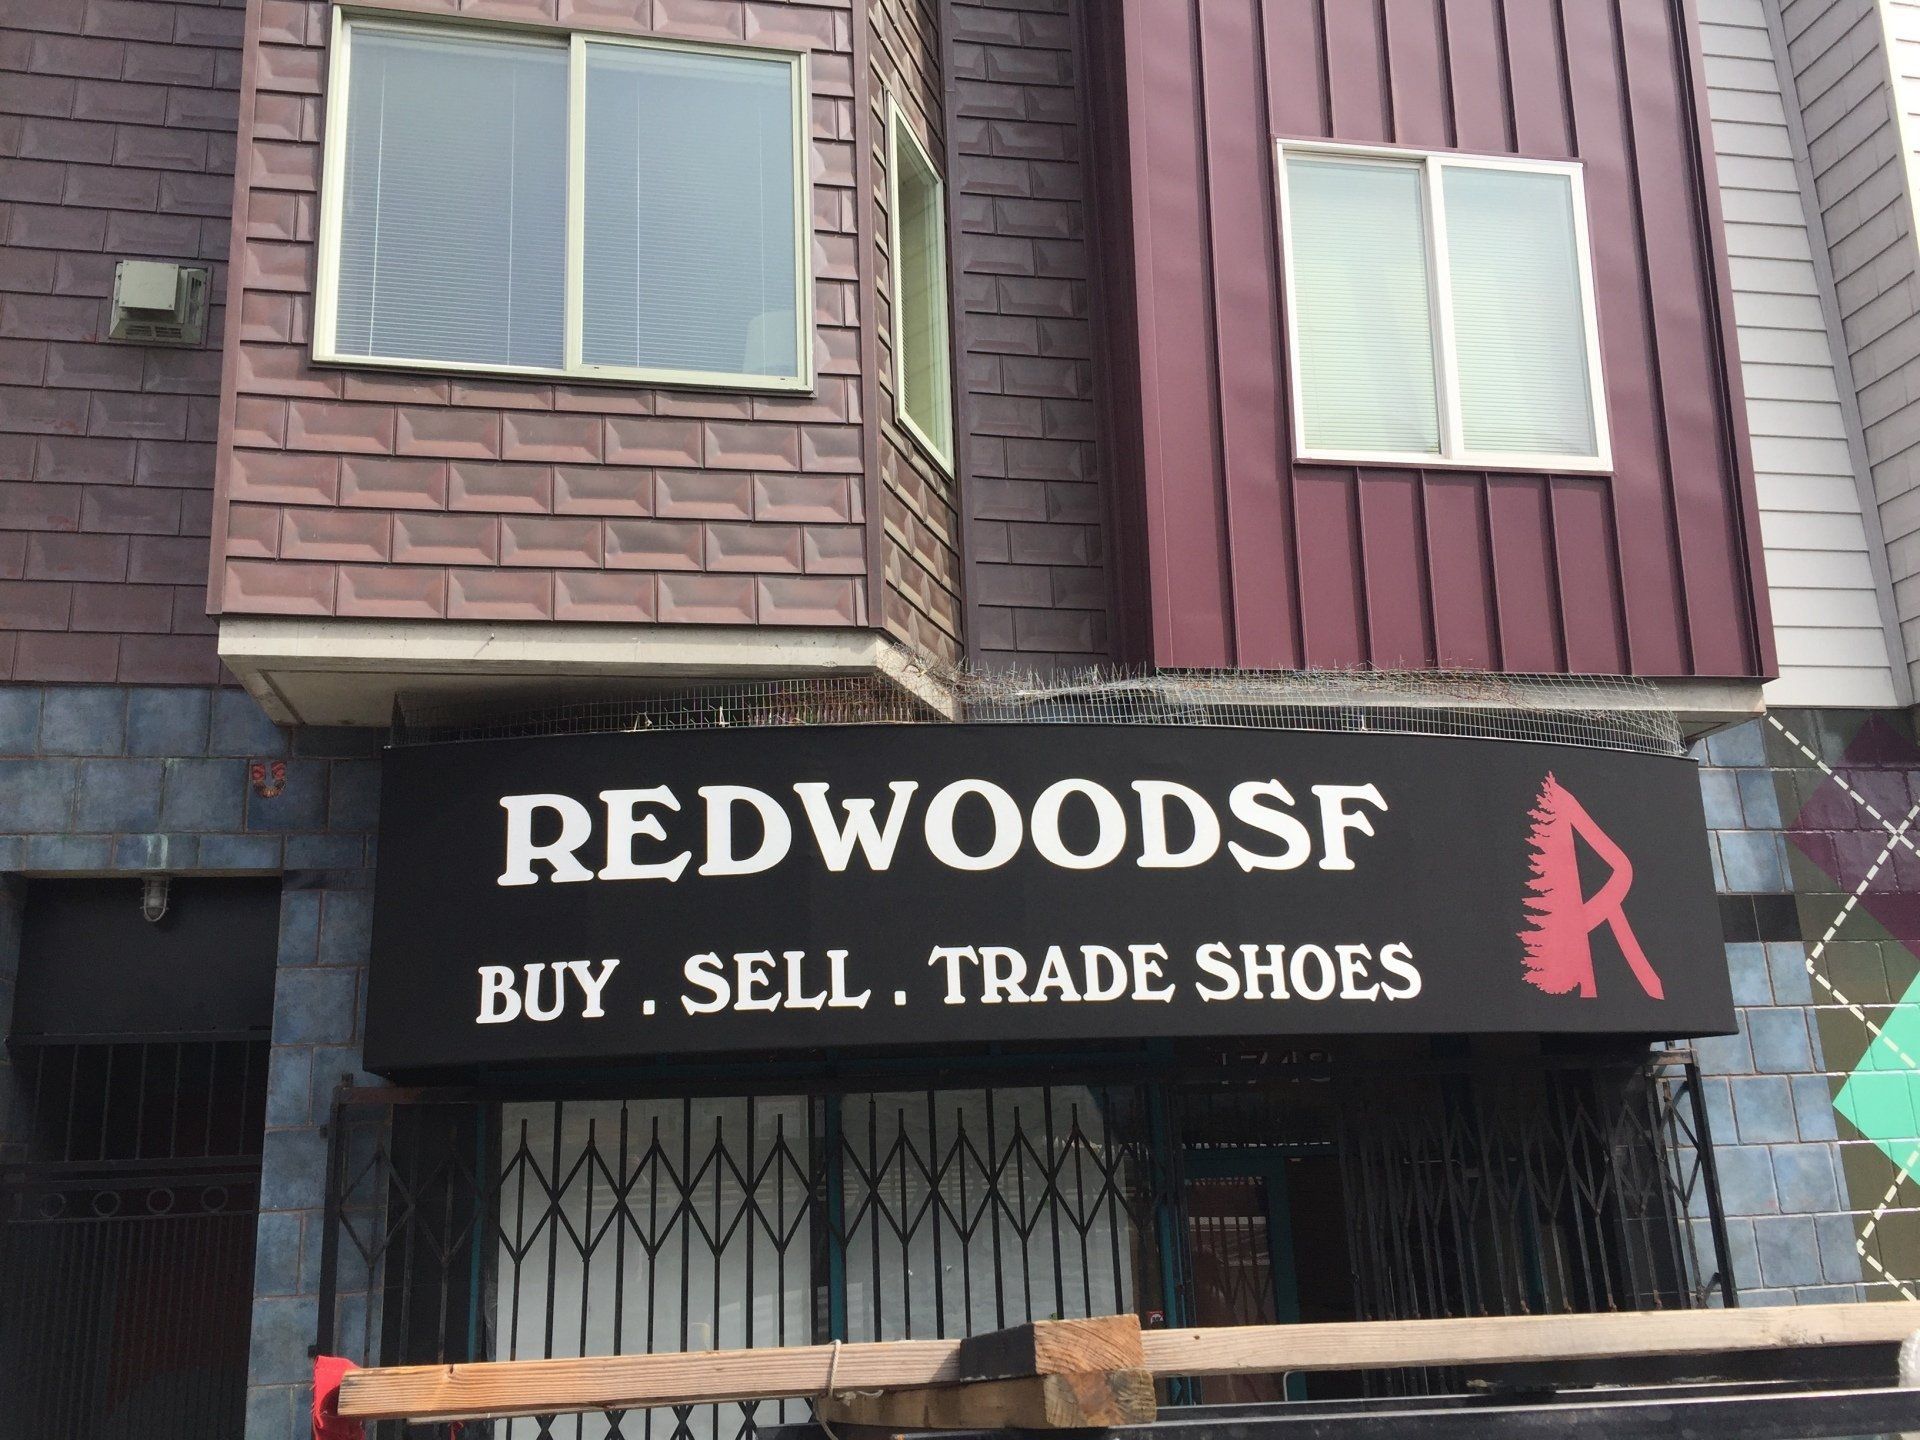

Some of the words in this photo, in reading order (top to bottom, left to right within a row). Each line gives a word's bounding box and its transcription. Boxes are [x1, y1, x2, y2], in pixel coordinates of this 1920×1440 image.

[496, 778, 1389, 887] REDWOODSF
[475, 958, 621, 1024] BUY
[680, 949, 872, 1013] SELL
[927, 941, 1176, 1005] TRADE
[1195, 941, 1422, 1004] SHOES
